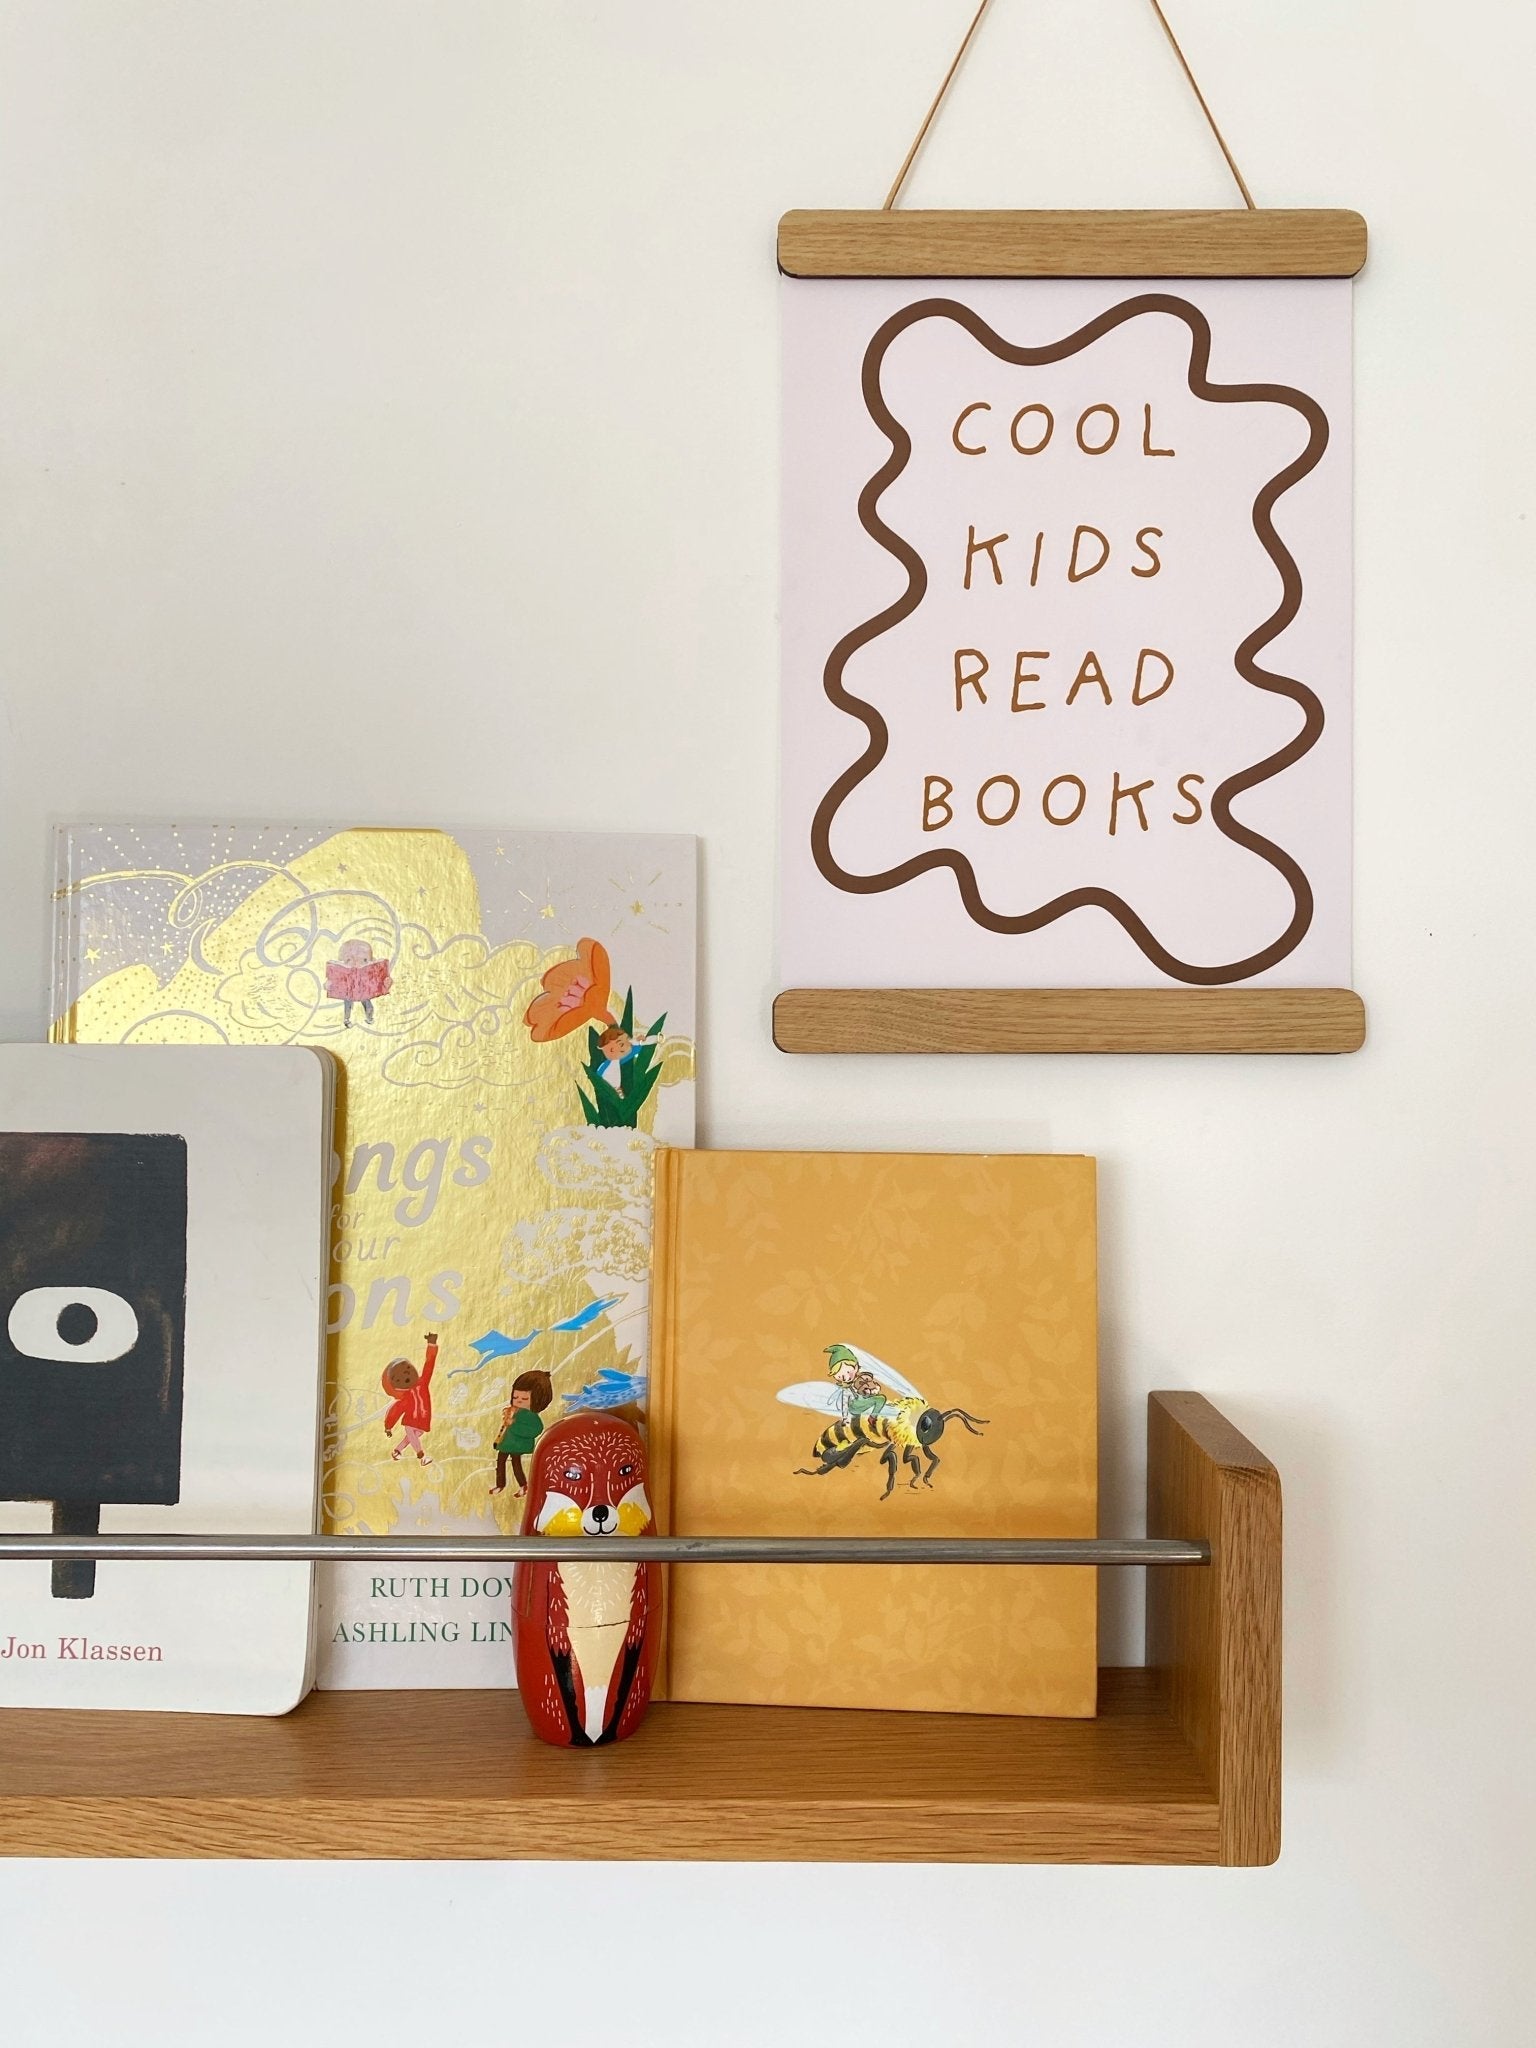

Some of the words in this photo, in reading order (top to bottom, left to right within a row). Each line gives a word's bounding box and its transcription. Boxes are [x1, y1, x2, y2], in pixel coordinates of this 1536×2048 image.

[952, 402, 1175, 456] COOL
[963, 524, 1163, 590] KIDS
[954, 648, 1175, 712] READ
[922, 771, 1205, 836] BOOKS
[331, 1135, 493, 1227] ngs
[332, 1236, 401, 1263] our
[371, 1577, 448, 1598] RUTH
[0, 1636, 47, 1659] Jon
[57, 1637, 164, 1662] Klassen
[332, 1622, 461, 1643] ASHLING
